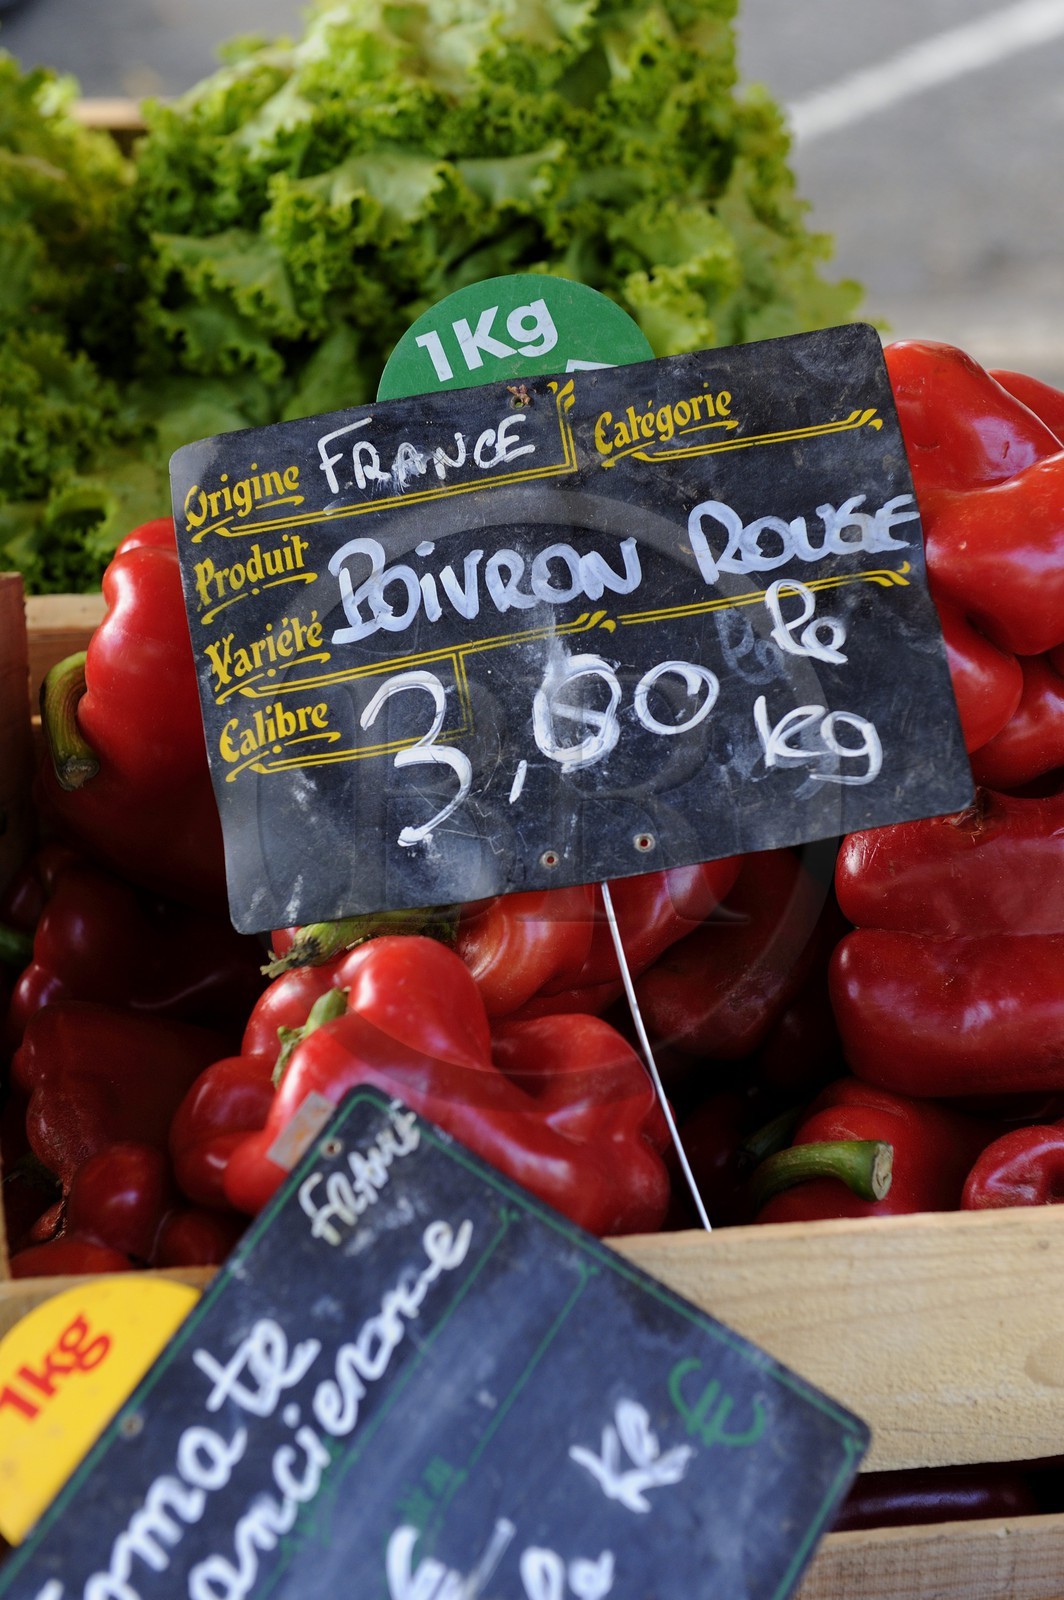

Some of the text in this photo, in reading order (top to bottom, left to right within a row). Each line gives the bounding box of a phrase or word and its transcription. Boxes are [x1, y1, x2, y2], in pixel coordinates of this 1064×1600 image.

[415, 298, 558, 383] 1Kg
[594, 381, 732, 455] Catégorie
[184, 414, 536, 531] Origine FRANCE
[194, 535, 310, 611] Produit
[687, 493, 921, 585] ROUGE
[204, 609, 324, 691] Variété
[218, 702, 329, 763] Calibre
[0, 1311, 112, 1423] 1kg
